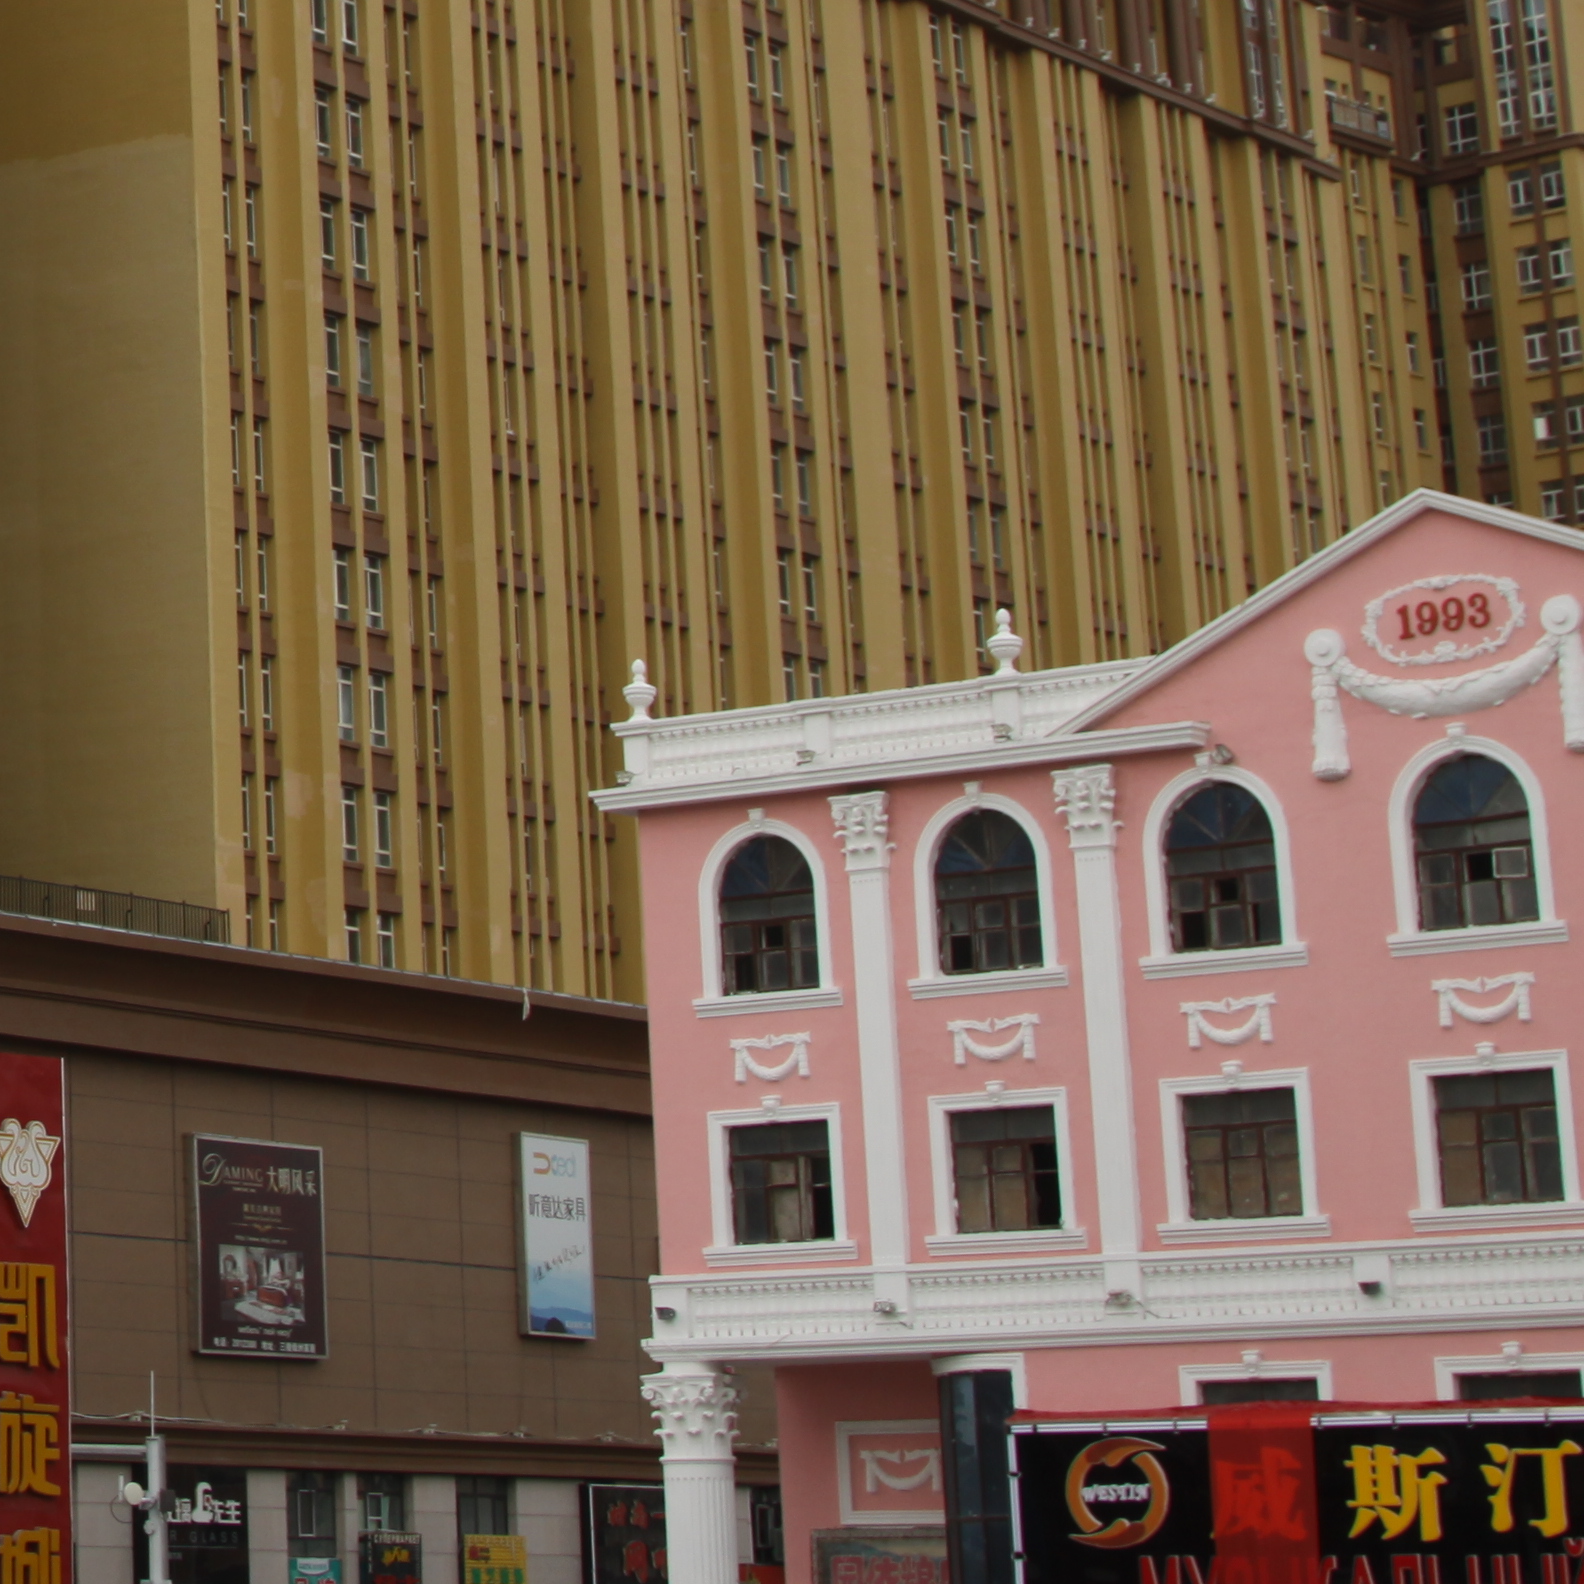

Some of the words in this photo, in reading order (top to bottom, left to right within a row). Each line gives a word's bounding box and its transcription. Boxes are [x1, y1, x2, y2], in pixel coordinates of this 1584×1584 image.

[1395, 592, 1491, 641] 1993
[266, 1166, 317, 1197] 大明风采
[1081, 1482, 1151, 1503] WESTIN
